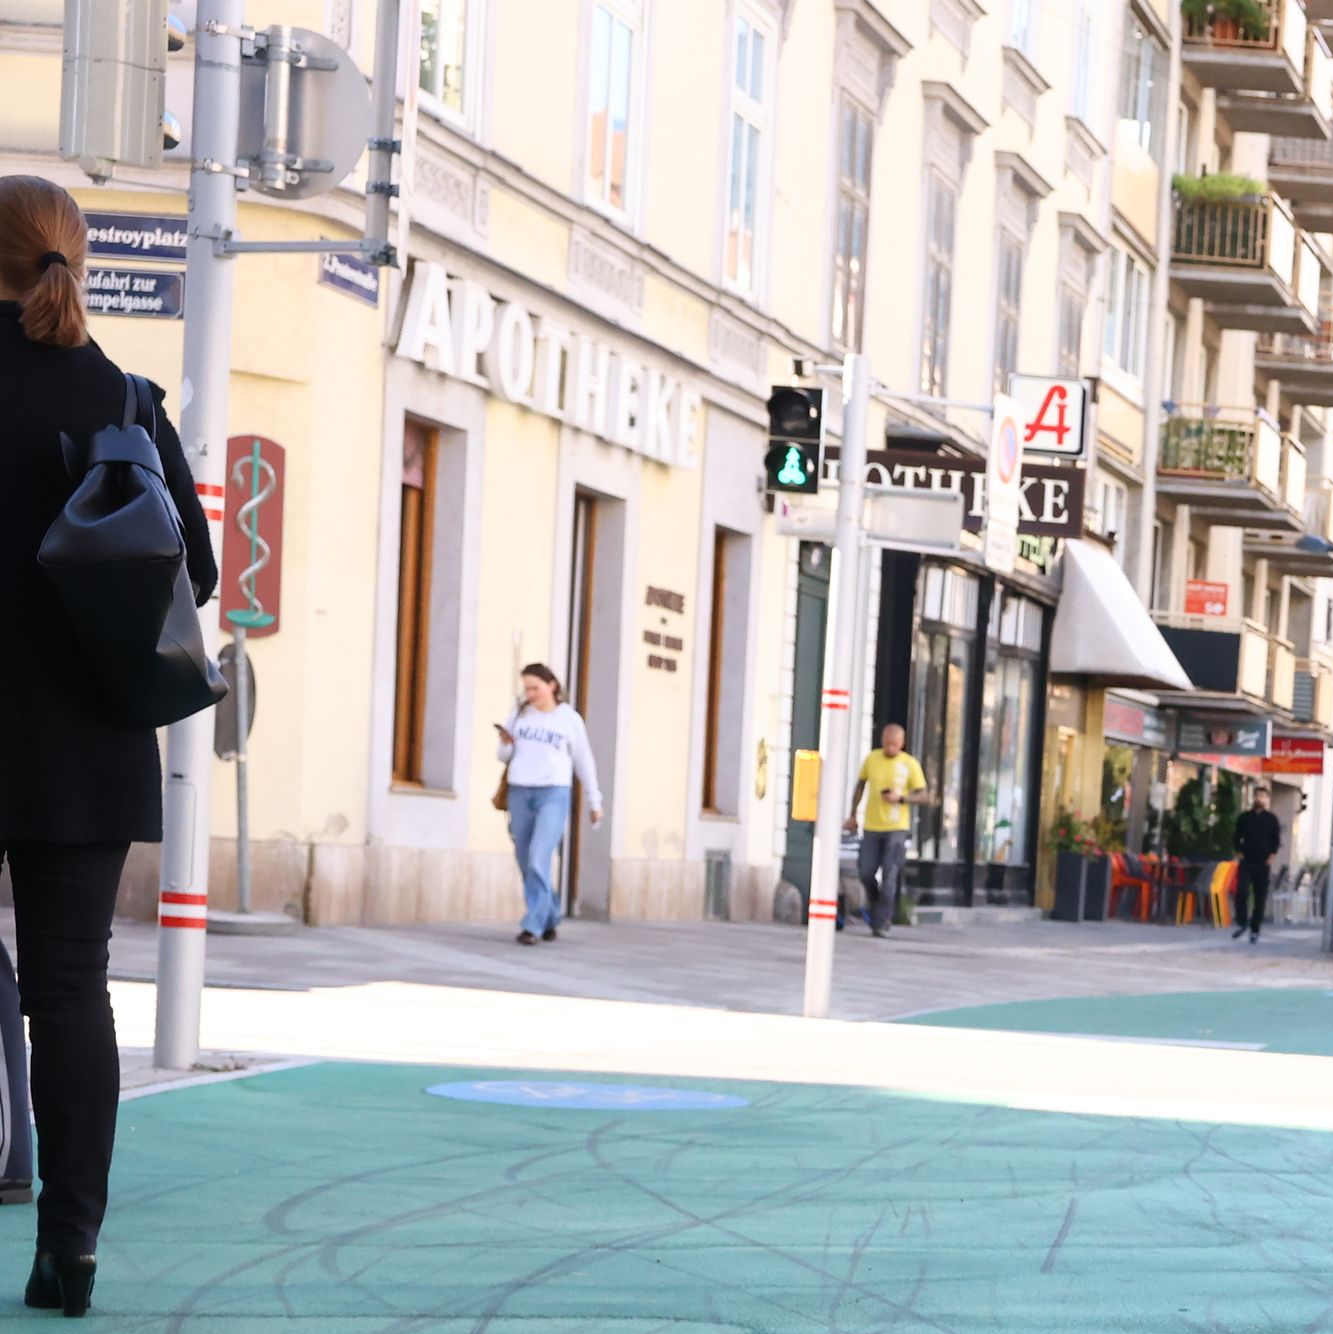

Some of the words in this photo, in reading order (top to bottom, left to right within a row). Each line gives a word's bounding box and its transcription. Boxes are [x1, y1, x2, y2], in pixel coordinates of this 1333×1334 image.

[86, 226, 188, 249] estroyplatz
[131, 277, 157, 292] zur
[395, 261, 699, 470] APOTHEKE
